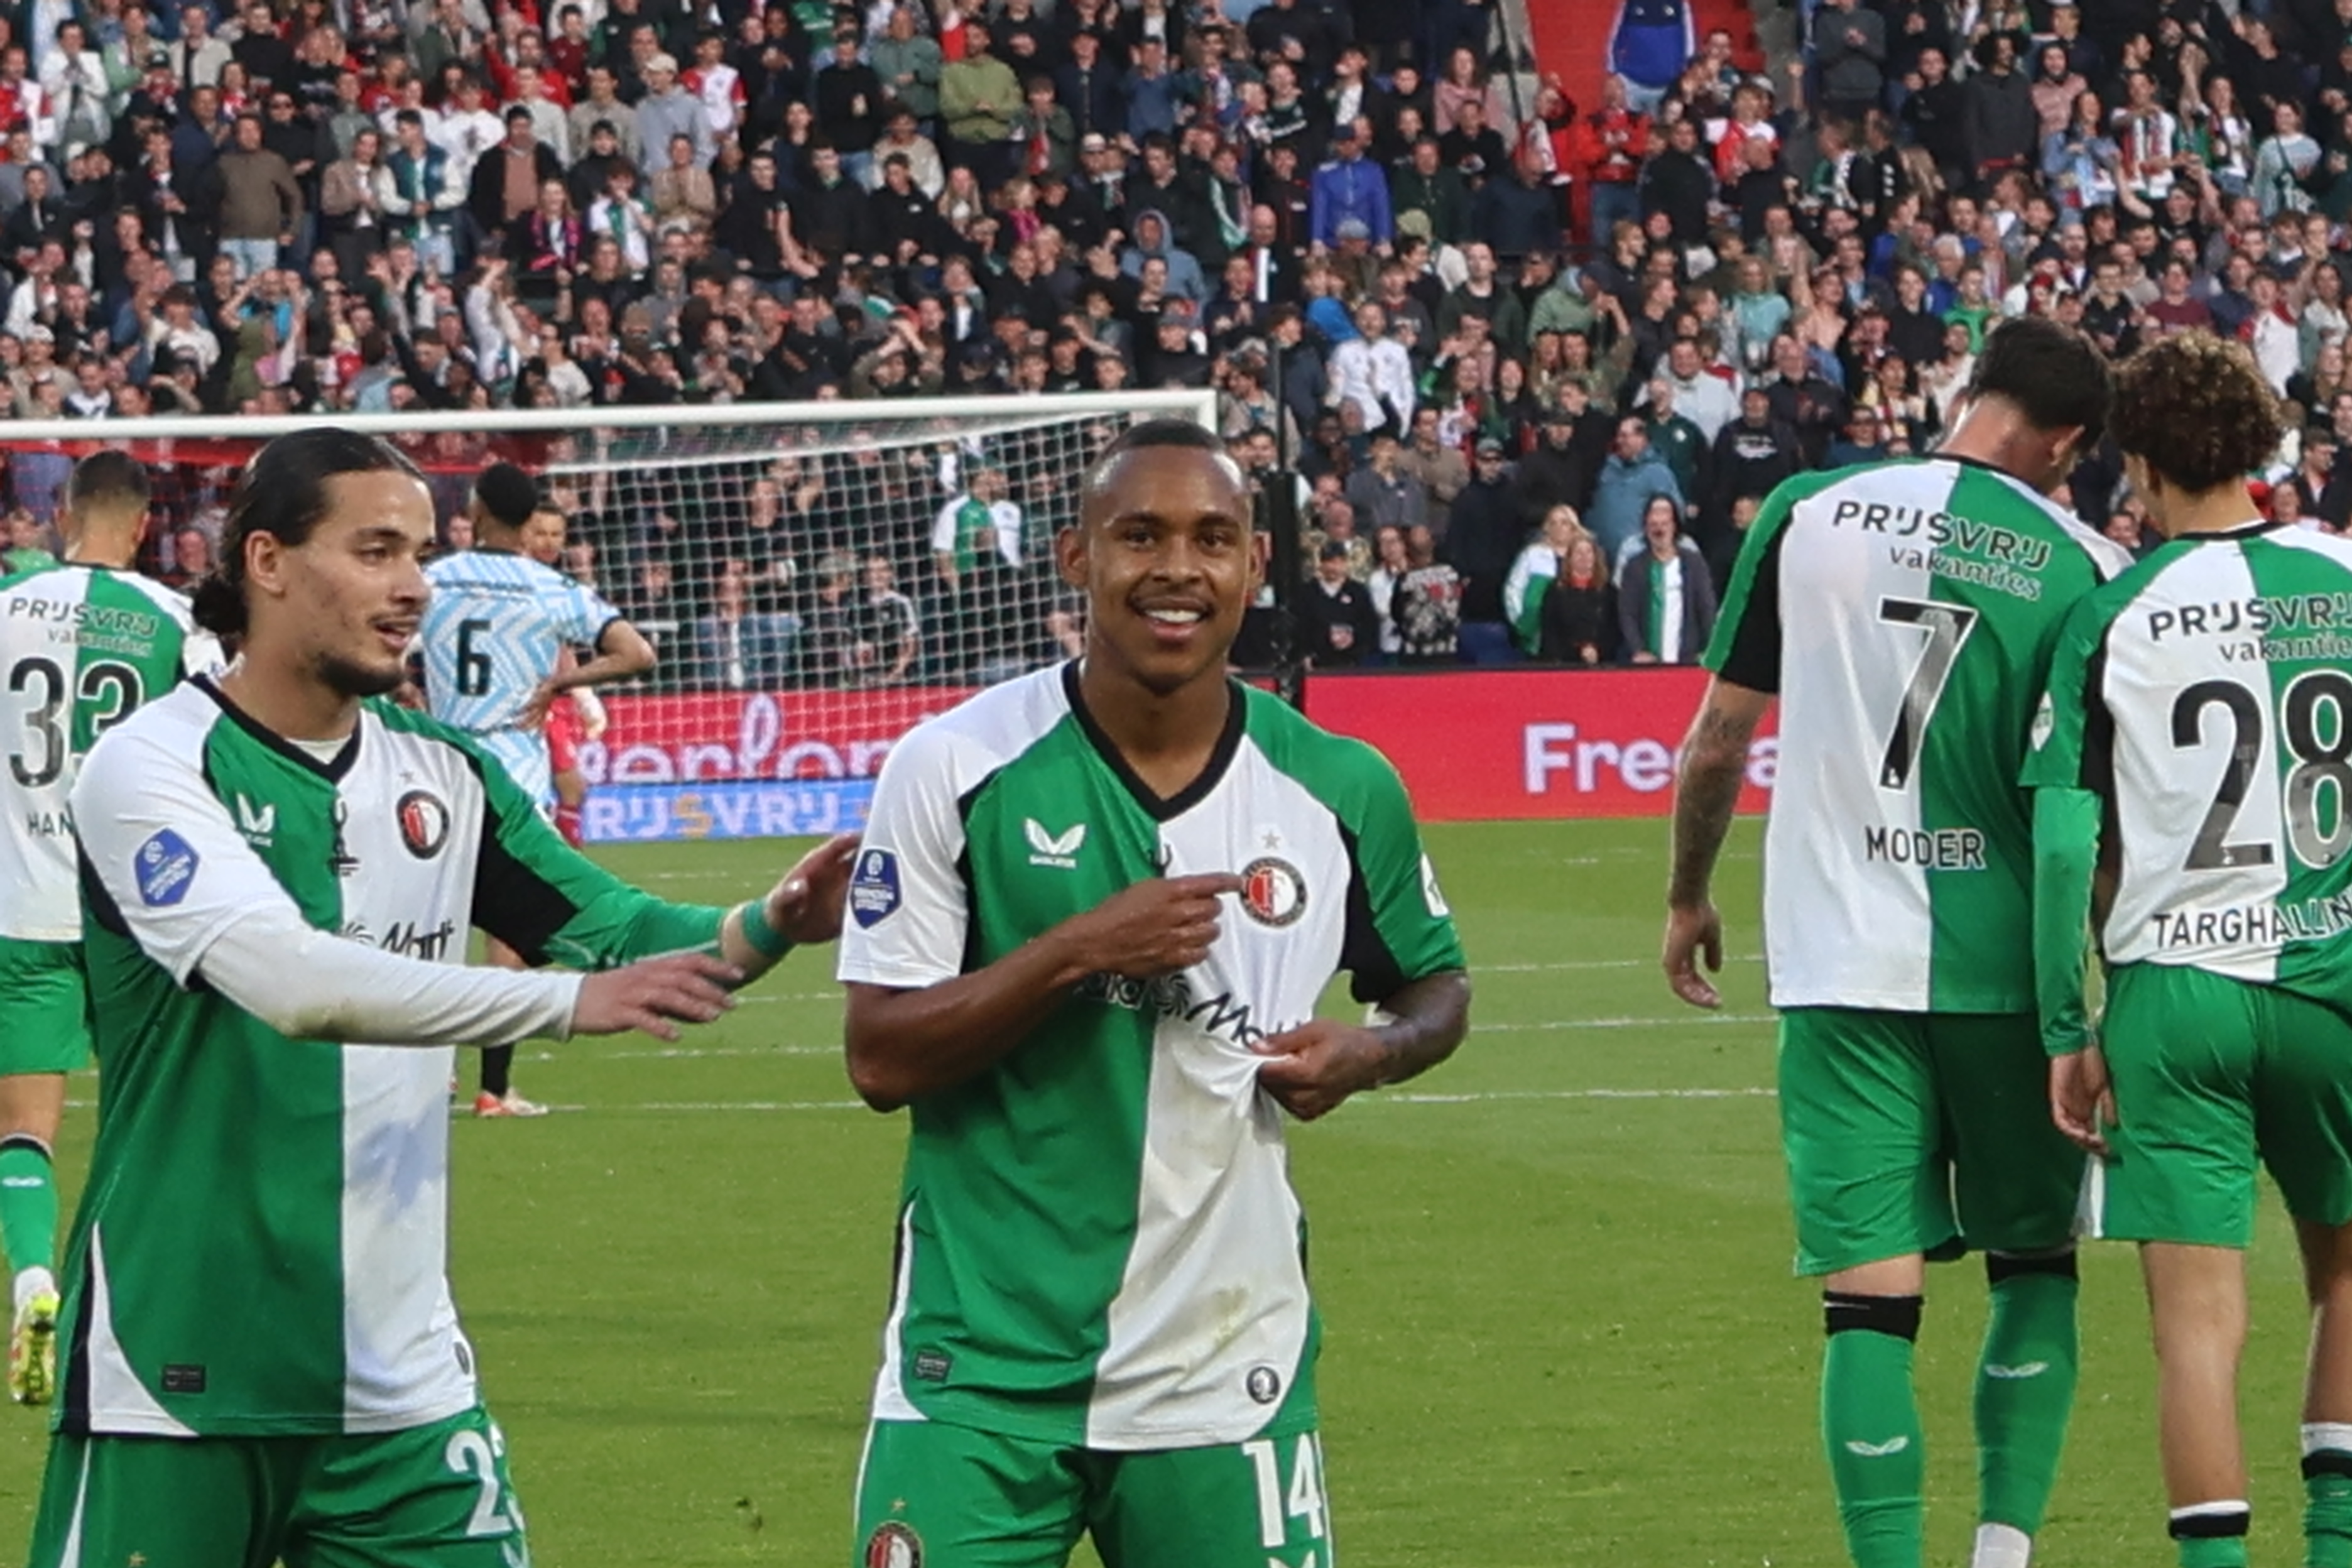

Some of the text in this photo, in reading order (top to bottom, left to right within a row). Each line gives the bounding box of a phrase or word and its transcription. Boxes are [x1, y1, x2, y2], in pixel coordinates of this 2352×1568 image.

[1833, 501, 2051, 571] PRIJSVRIJ
[1890, 546, 2041, 601] vakanties
[456, 618, 492, 696] 6
[1876, 596, 1979, 793] 7
[2171, 668, 2352, 873] 28
[1865, 826, 1987, 870] MODER
[1243, 1433, 1324, 1548] 14
